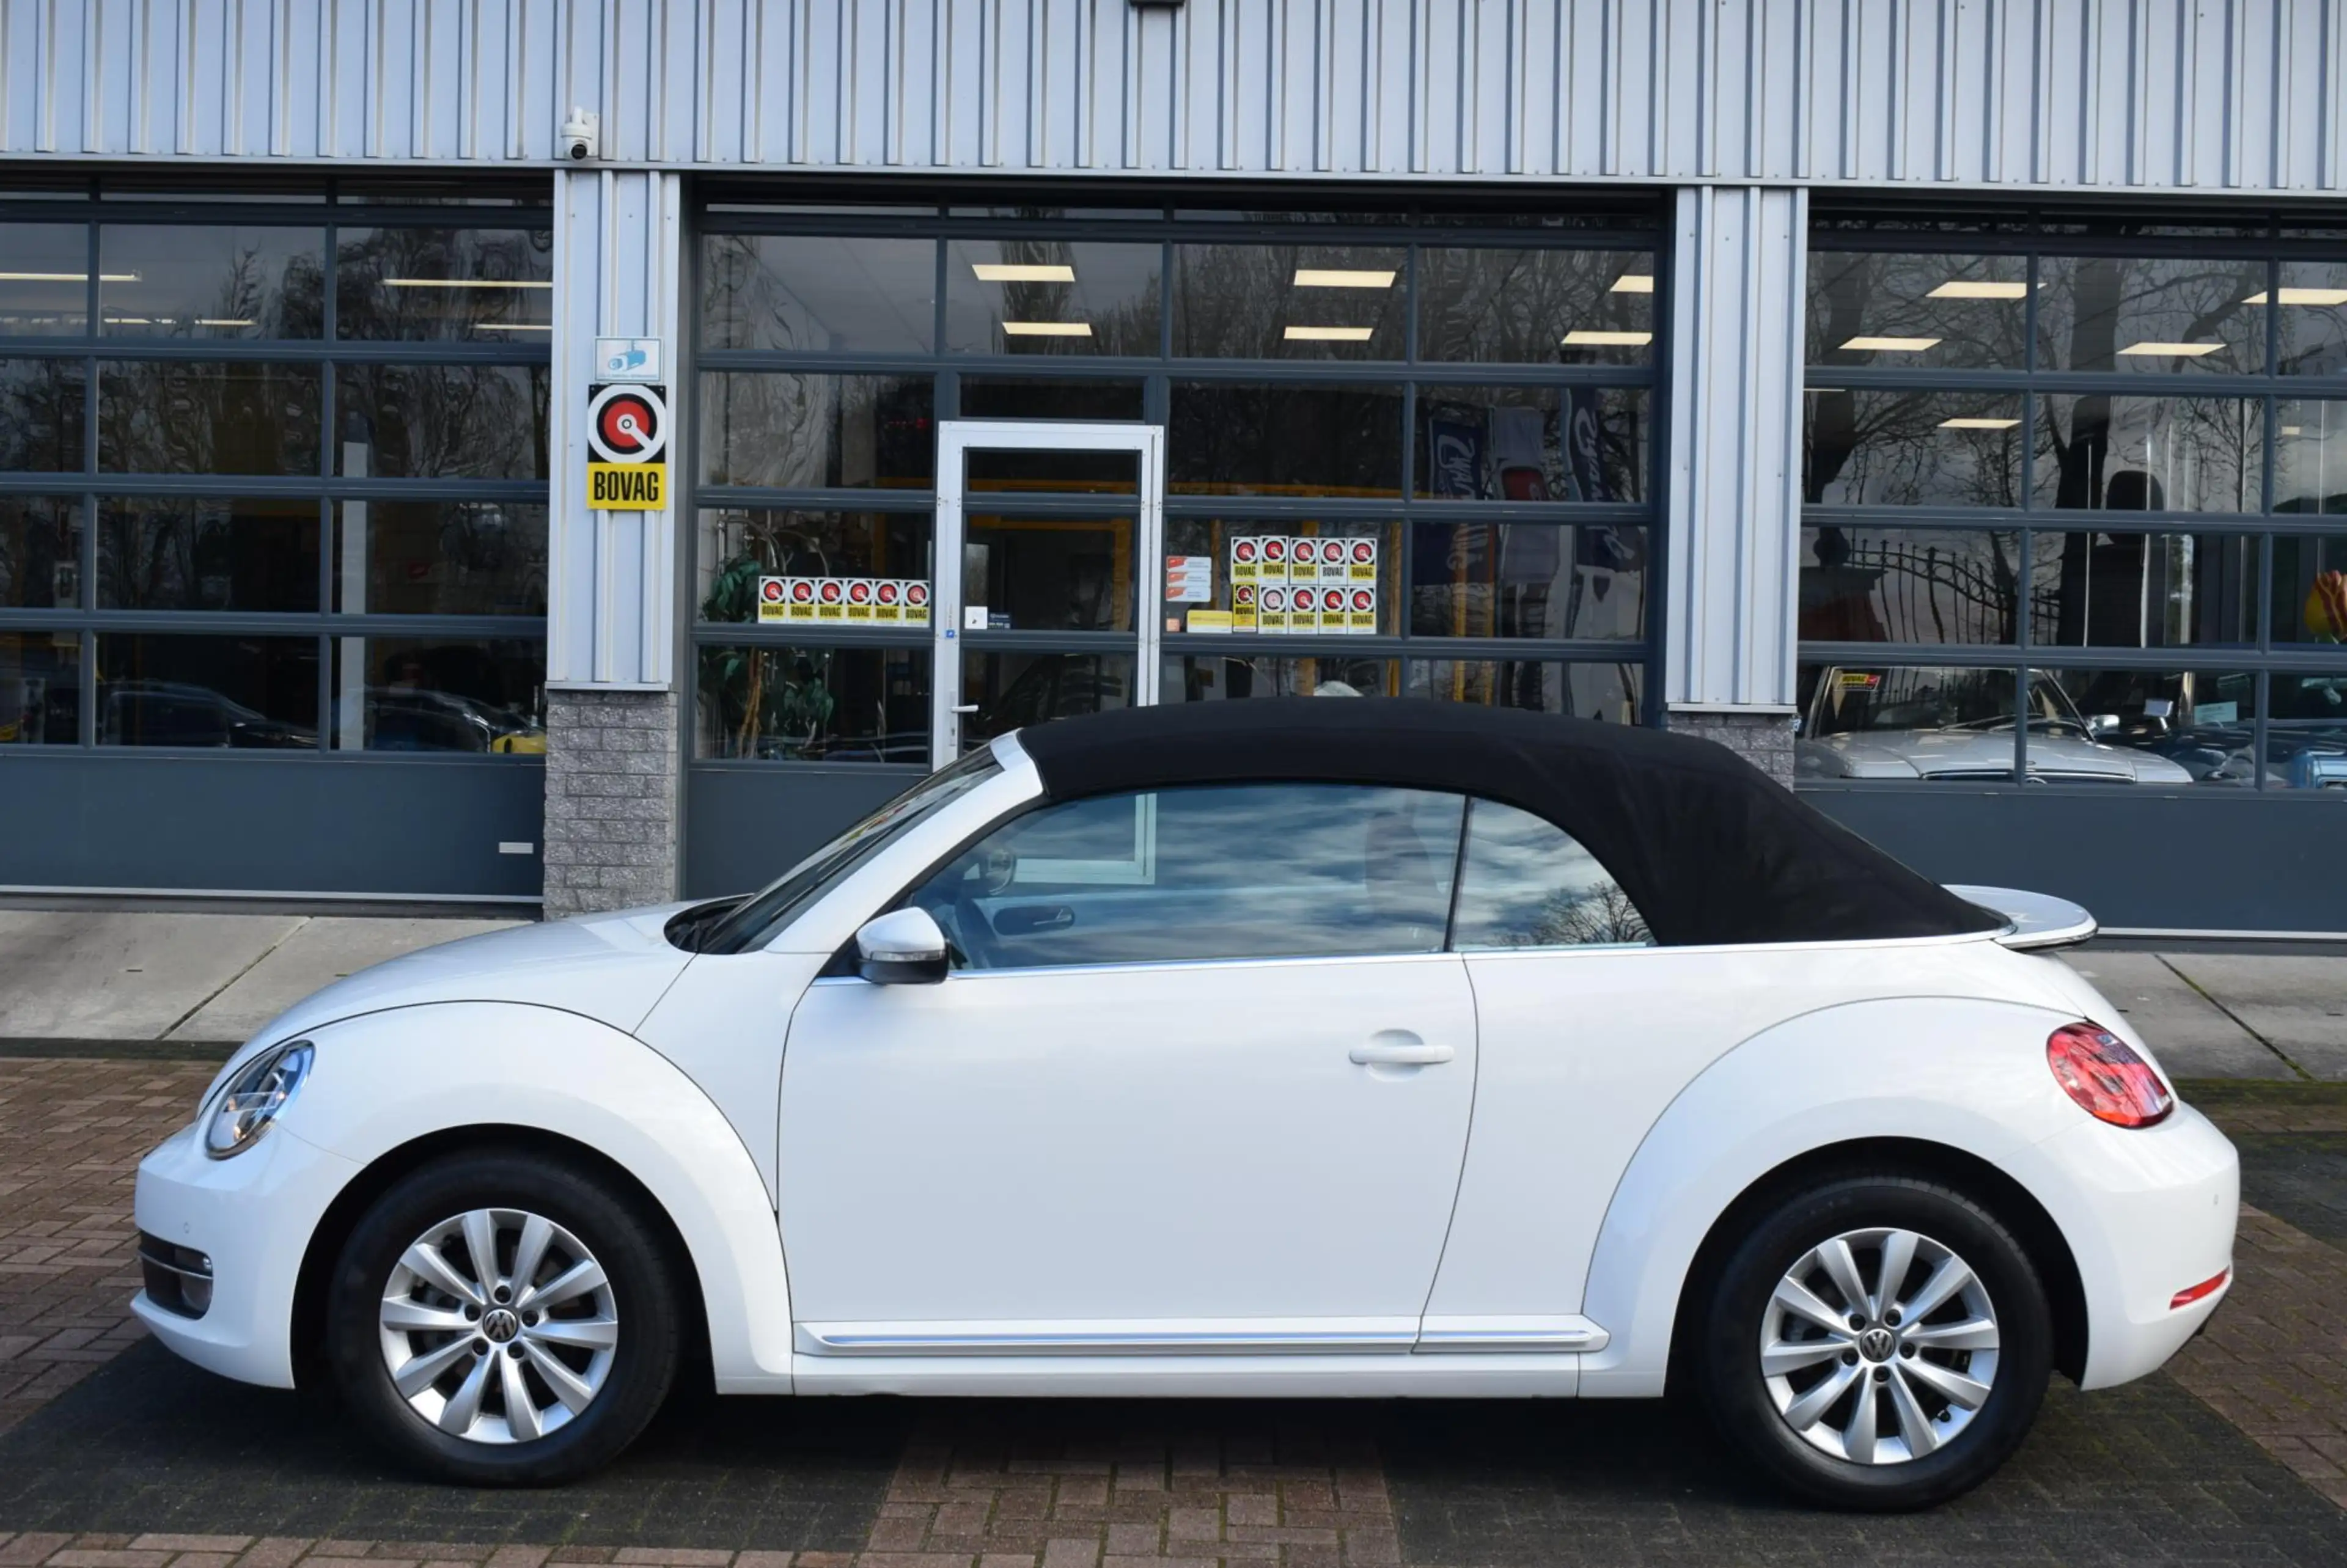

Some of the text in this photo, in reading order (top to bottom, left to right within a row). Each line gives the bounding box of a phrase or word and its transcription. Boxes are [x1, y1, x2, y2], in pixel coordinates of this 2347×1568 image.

[593, 471, 659, 501] BOVAG
[1235, 566, 1256, 576] BOVAG
[1263, 564, 1284, 574] BOVAG
[1293, 566, 1315, 577] BOVAG
[1323, 566, 1344, 577] BOVAG
[1351, 567, 1373, 577] BOVAG
[762, 605, 784, 615] BOVAG
[790, 606, 813, 616] BOVAG
[820, 606, 842, 617] BOVAG
[848, 607, 870, 617] BOVAG
[876, 608, 898, 618] BOVAG
[905, 609, 927, 618] BOVAG
[1263, 614, 1284, 625] BOVAG
[1293, 614, 1314, 625] BOVAG
[1323, 614, 1344, 624] BOVAG
[1352, 615, 1373, 625] BOVAG
